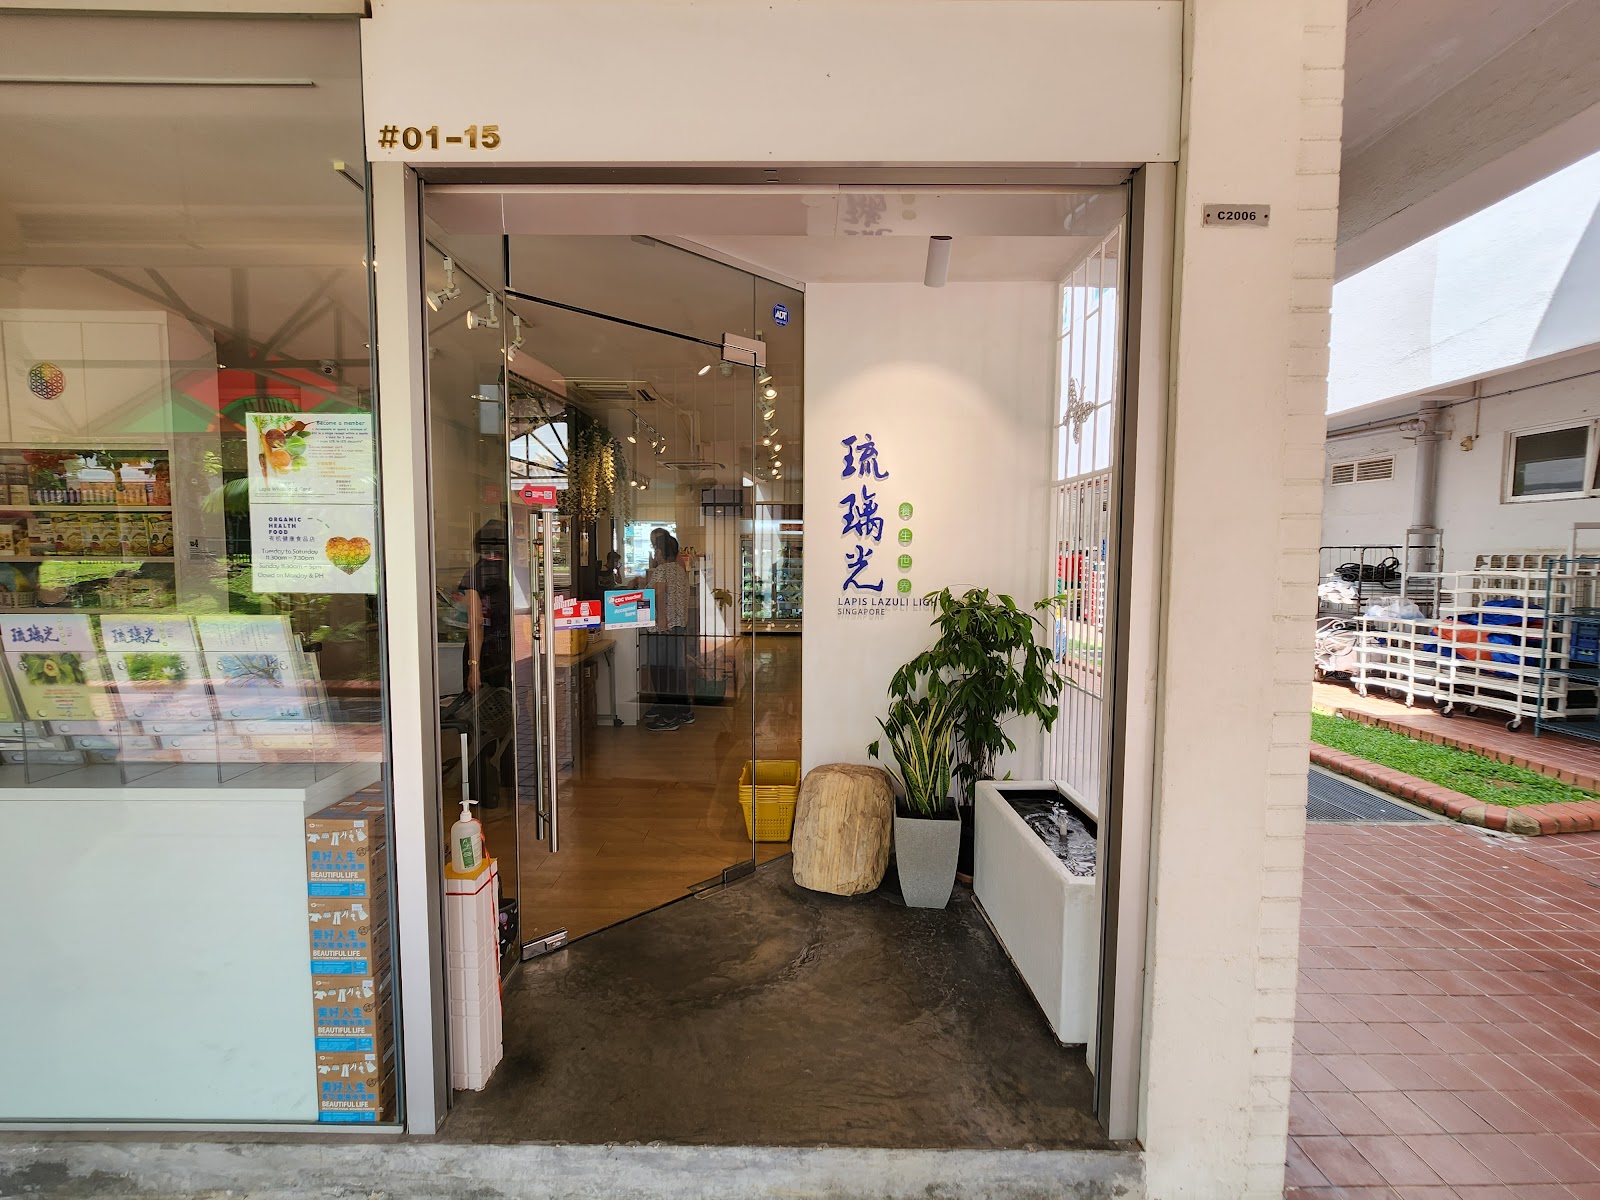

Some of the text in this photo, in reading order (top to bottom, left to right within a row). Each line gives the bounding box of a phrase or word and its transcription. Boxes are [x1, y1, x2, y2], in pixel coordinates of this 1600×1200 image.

[378, 125, 500, 150] #01-15
[1217, 211, 1257, 221] C2006
[774, 309, 787, 321] ADT
[839, 433, 889, 592] 琉璃光
[837, 597, 941, 607] LAPIS LAZULI LIGH
[837, 608, 885, 616] SINGAPORE
[10, 624, 59, 643] 琉璃光
[111, 625, 160, 644] 琉璃光
[311, 850, 356, 862] 美好人生
[313, 929, 358, 940] 美好人生
[317, 1007, 363, 1018] 美好人生
[318, 1026, 351, 1034] BEAUTIFUL
[321, 1081, 366, 1093] 美好人生
[321, 1100, 355, 1108] BEAUTIFUL
